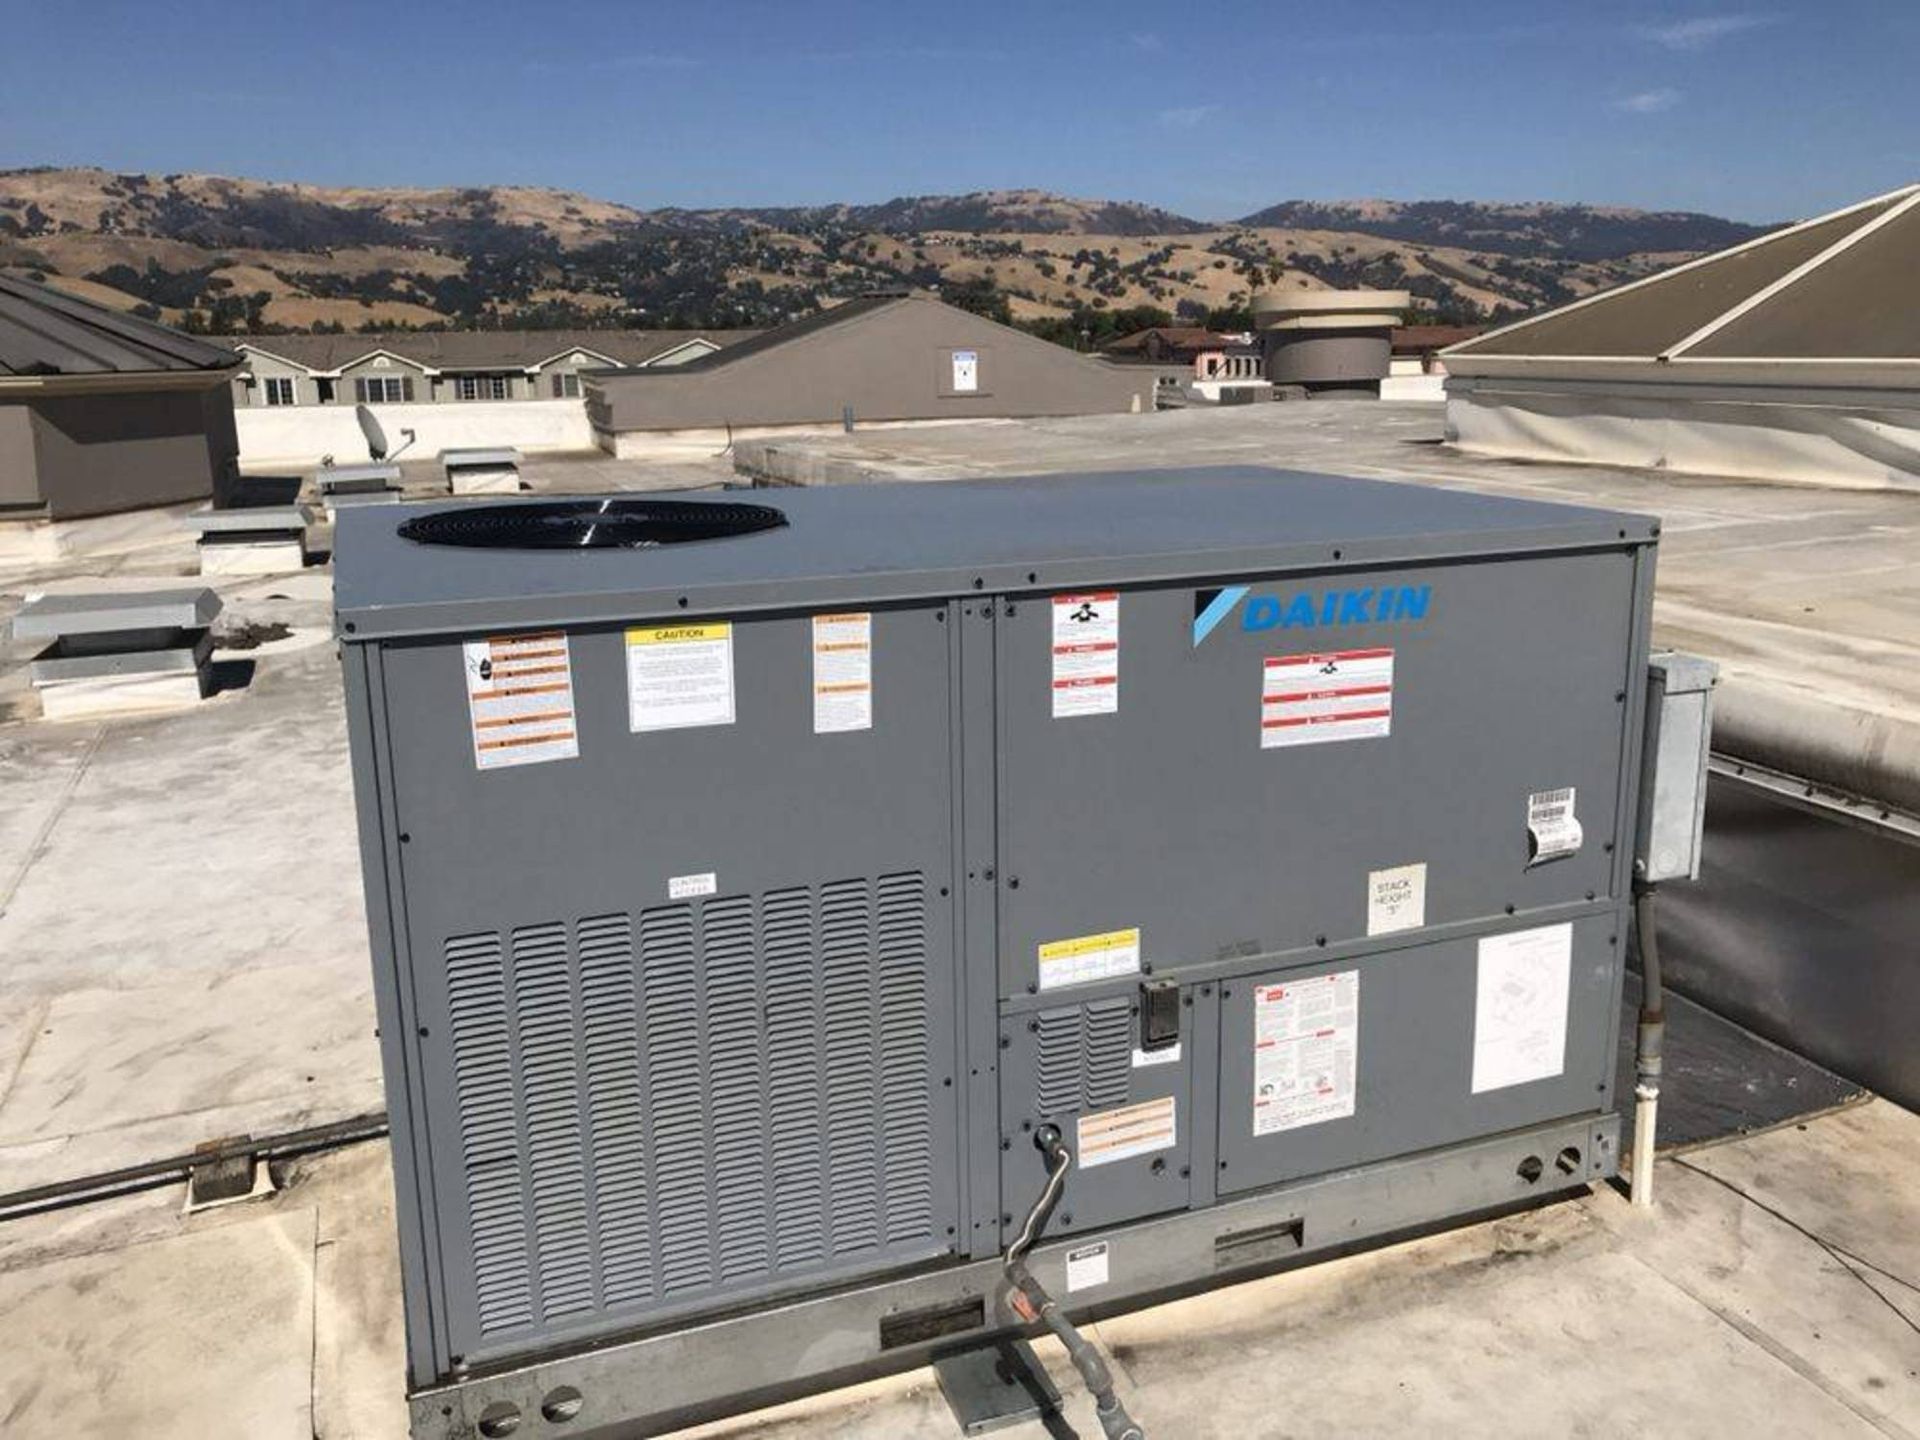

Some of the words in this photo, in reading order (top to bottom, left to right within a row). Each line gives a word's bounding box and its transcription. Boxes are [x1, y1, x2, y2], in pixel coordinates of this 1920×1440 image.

[1242, 584, 1432, 632] DAIKIN
[655, 629, 704, 640] CAUTION
[1377, 879, 1411, 893] STACK
